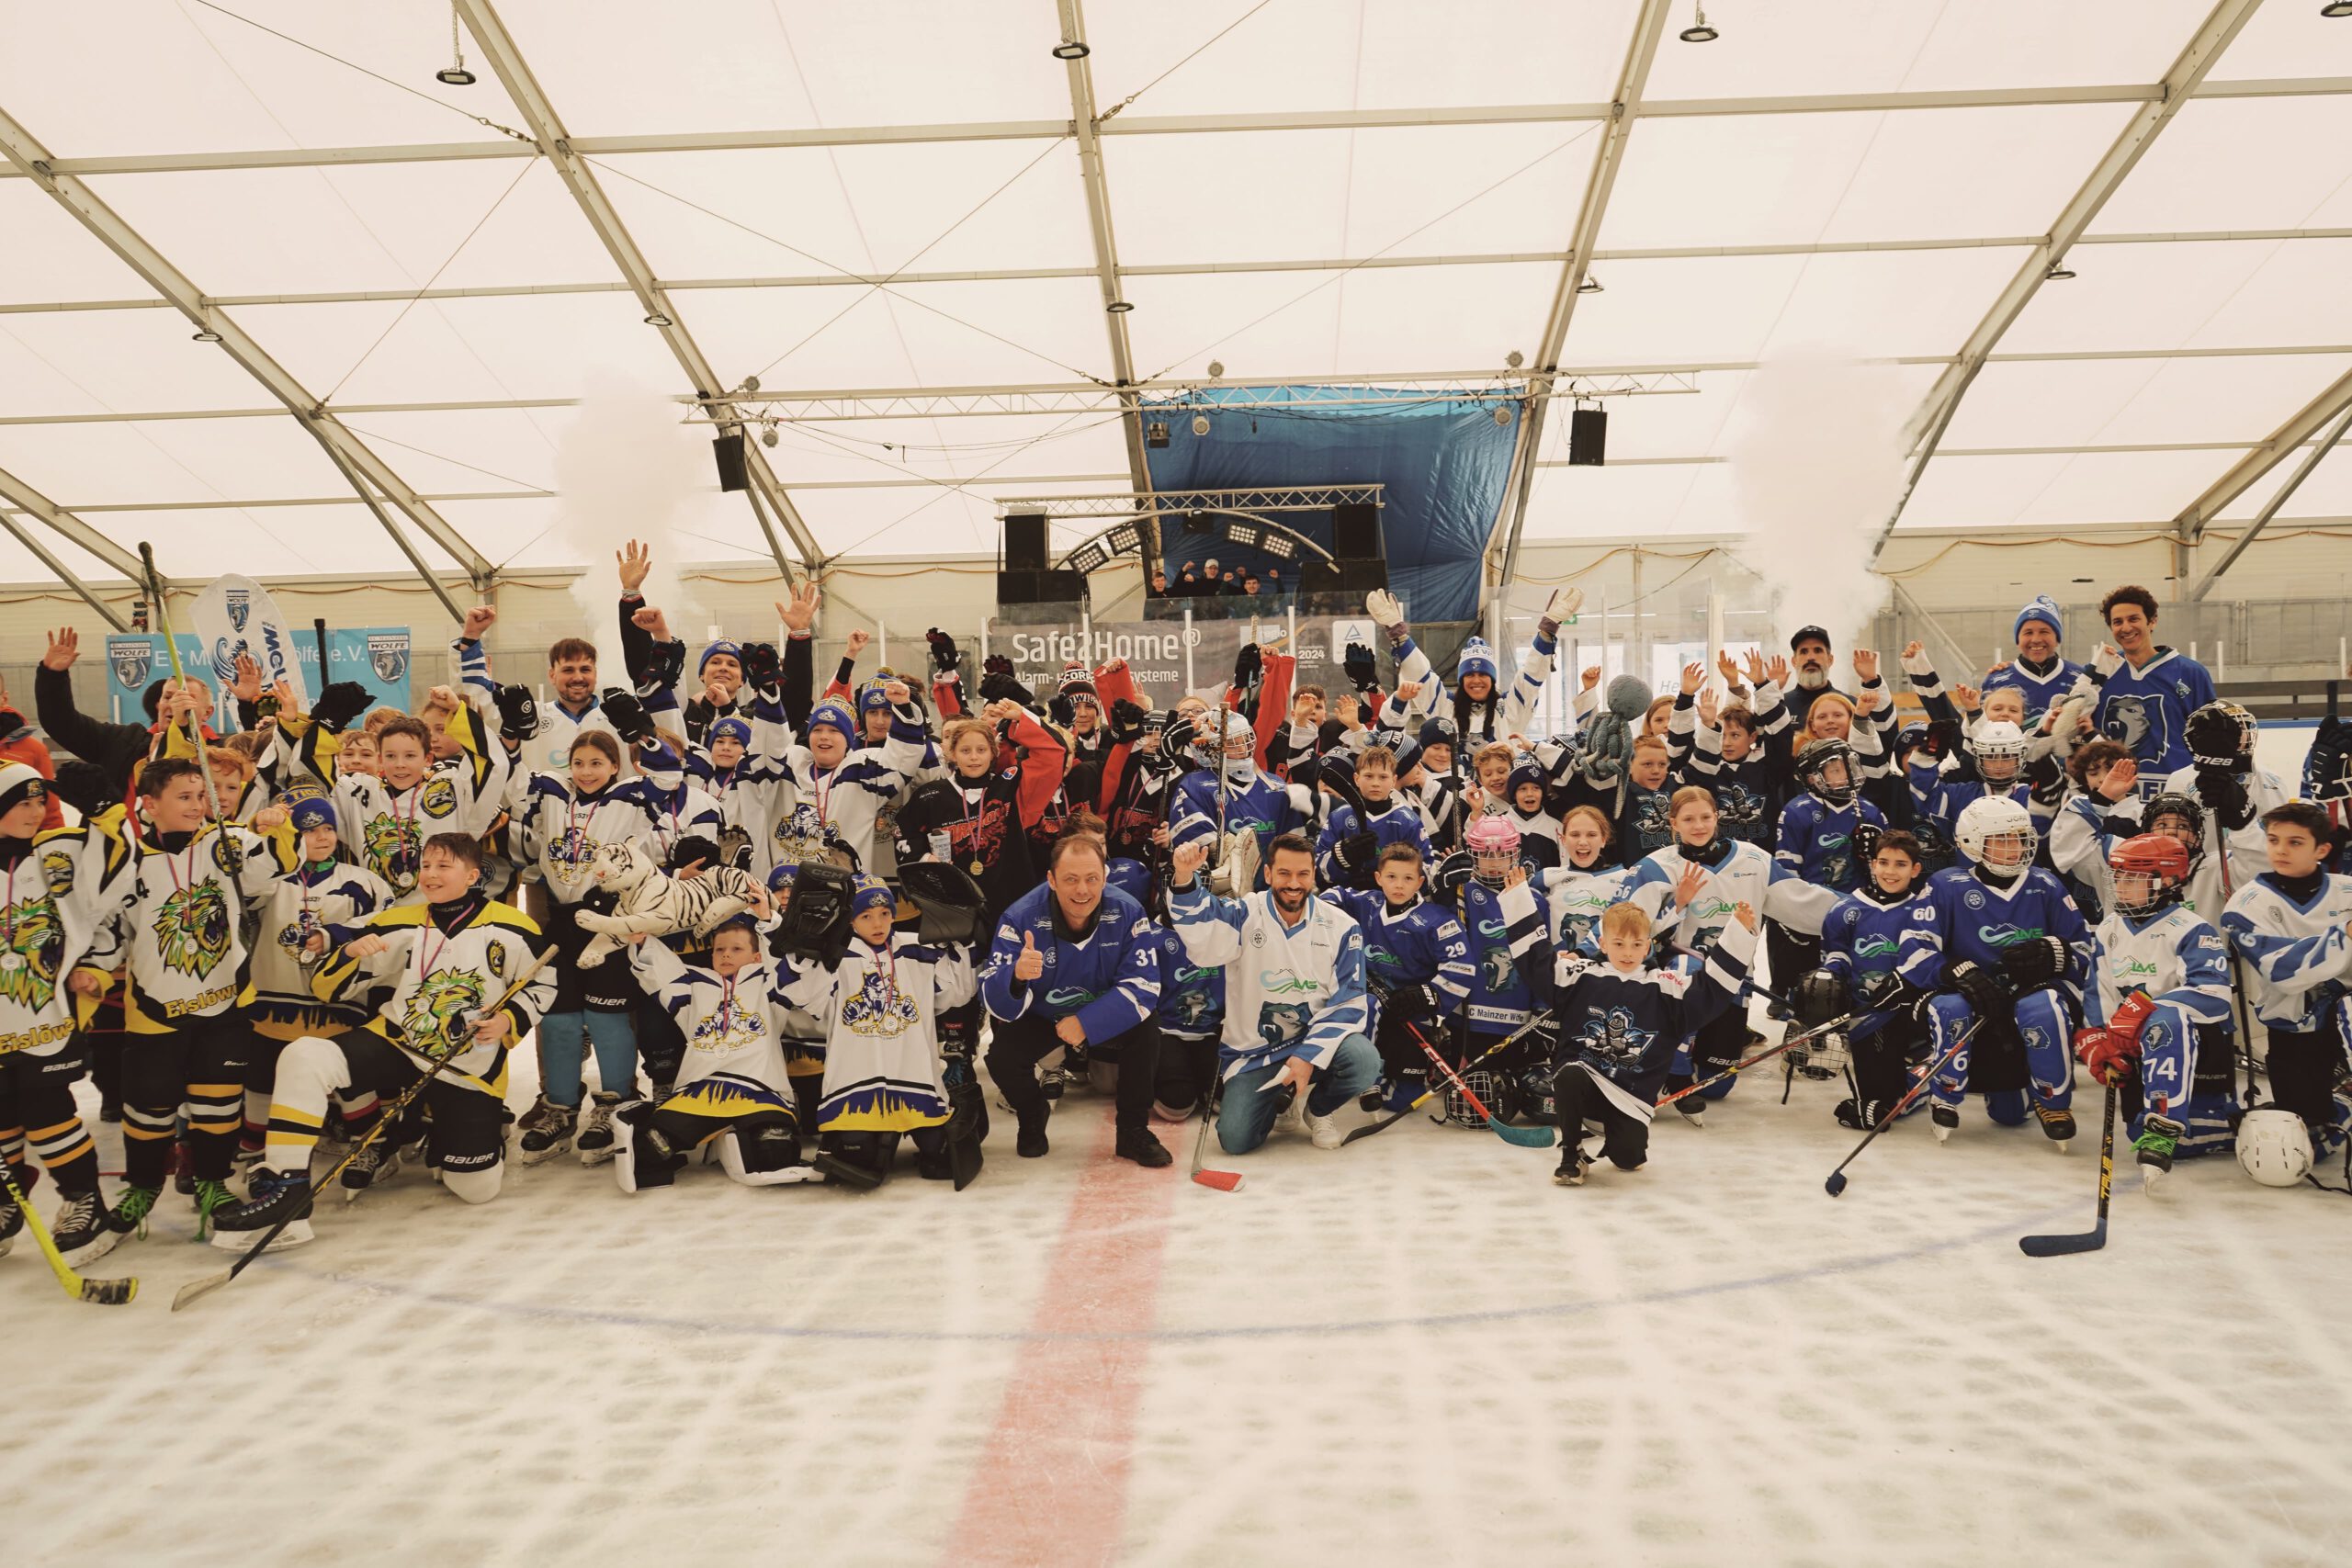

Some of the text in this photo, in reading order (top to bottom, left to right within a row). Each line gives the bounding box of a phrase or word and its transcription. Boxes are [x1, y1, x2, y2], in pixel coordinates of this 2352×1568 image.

[296, 646, 321, 662] ölfe
[1298, 649, 1326, 660] 2024
[1015, 671, 1054, 684] Alarm-
[1659, 680, 1680, 693] He
[811, 868, 843, 878] CCM
[1912, 905, 1936, 921] 60
[1136, 947, 1158, 966] 31
[1445, 942, 1467, 958] 29
[991, 952, 1012, 965] 31
[1469, 1007, 1475, 1017] C
[1477, 1009, 1509, 1021] Mainzer
[42, 1059, 84, 1073] BAUER
[1708, 1056, 1740, 1067] BAUE
[2143, 1056, 2178, 1083] 74
[444, 1152, 495, 1165] BAUER
